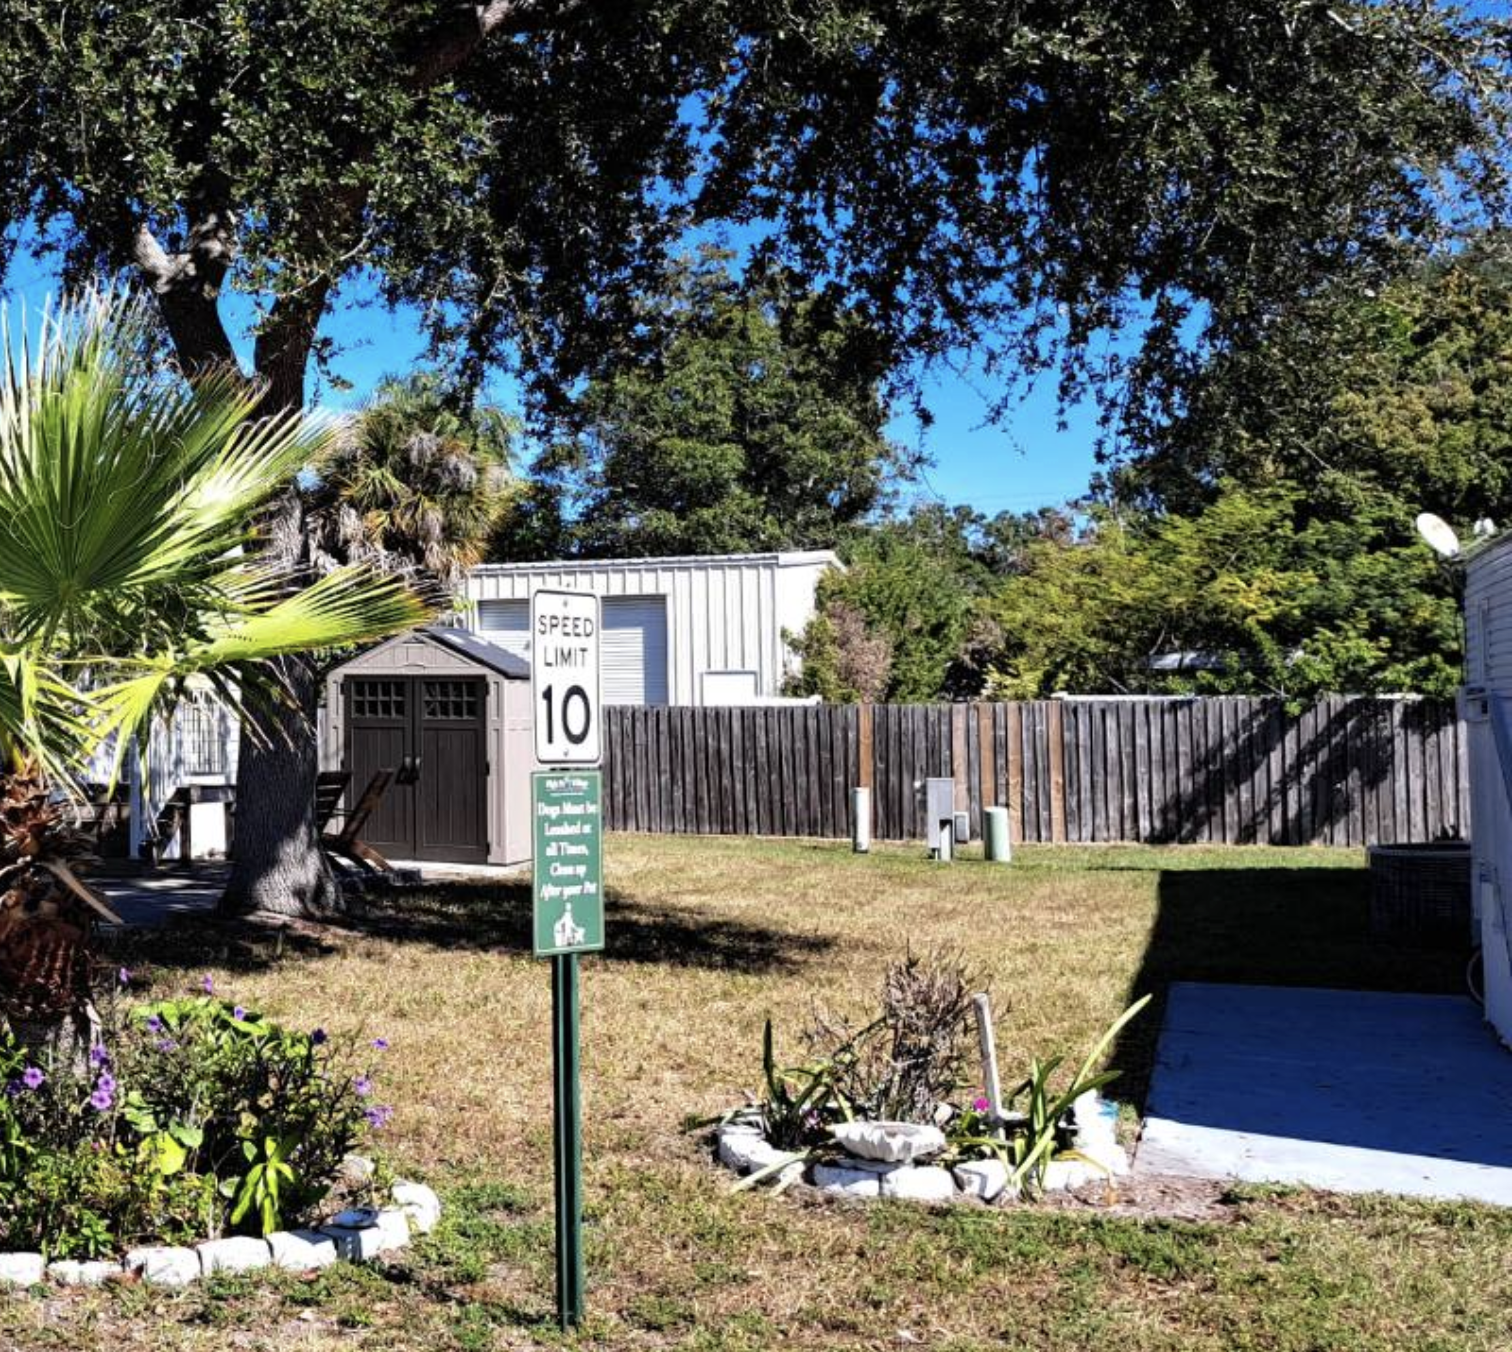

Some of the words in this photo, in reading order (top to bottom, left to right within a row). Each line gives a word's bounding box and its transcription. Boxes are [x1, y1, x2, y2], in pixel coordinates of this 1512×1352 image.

[538, 615, 594, 637] SPEED
[544, 646, 588, 667] LIMIT
[542, 684, 591, 745] 10
[538, 802, 560, 819] Dogs
[562, 802, 584, 815] Must
[586, 800, 597, 814] be
[576, 865, 587, 878] up
